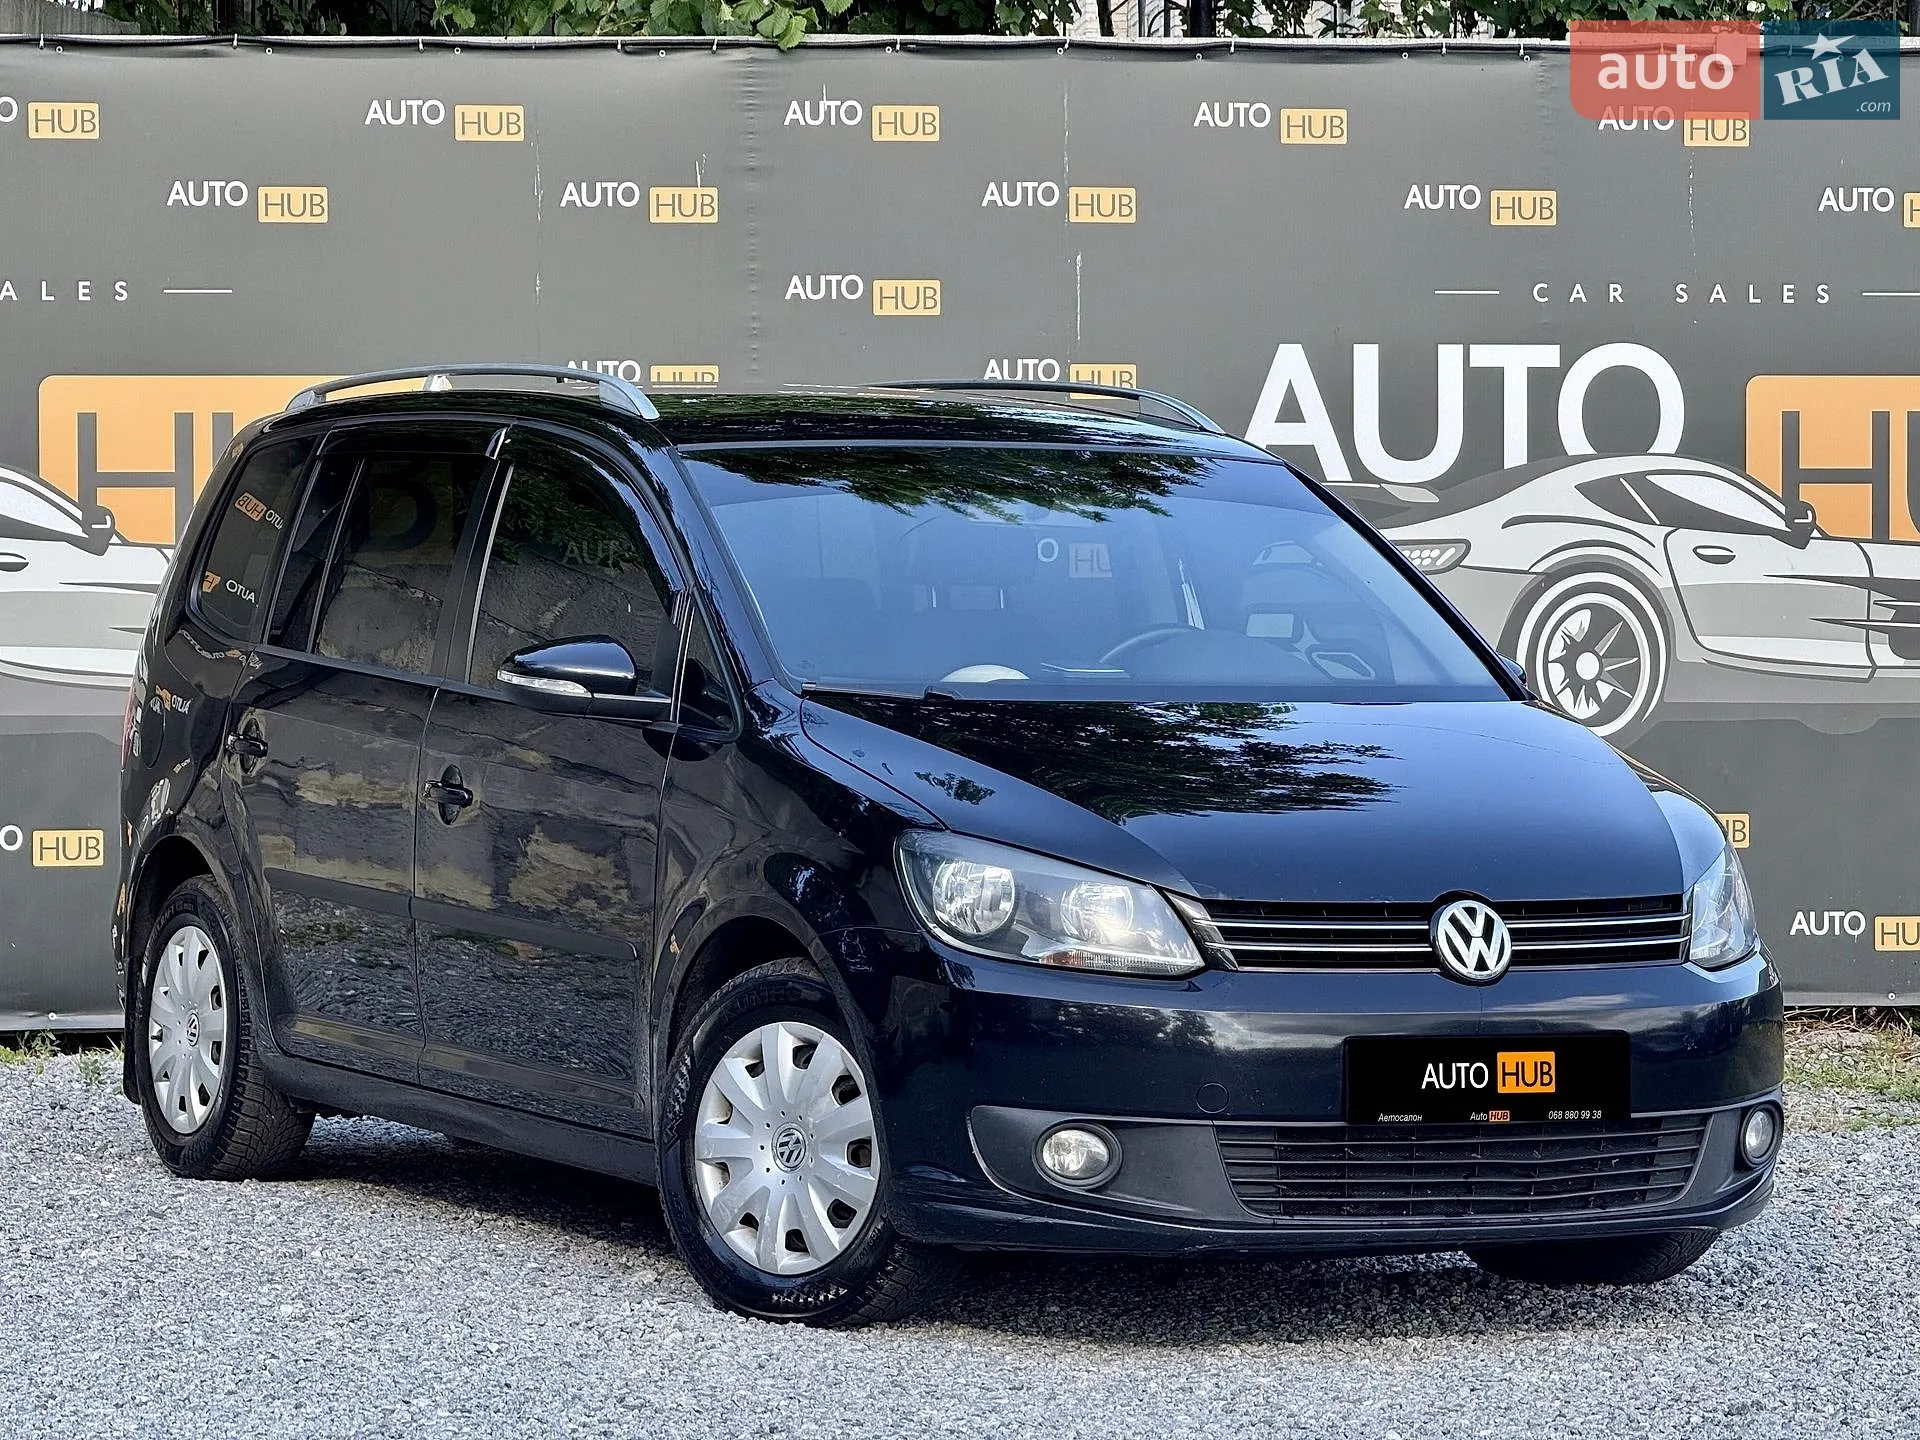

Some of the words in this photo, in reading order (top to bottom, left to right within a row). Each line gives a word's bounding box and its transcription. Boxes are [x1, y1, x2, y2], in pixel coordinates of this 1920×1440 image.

[34, 108, 97, 134] HUB
[364, 99, 446, 126] AUTO
[461, 110, 522, 137] HUB
[783, 100, 863, 126] AUTO
[878, 111, 937, 136] HUB
[1193, 101, 1272, 128] AUTO
[1286, 114, 1345, 139] HUB
[1598, 105, 1675, 131] AUTO
[1690, 118, 1748, 142] HUB
[166, 180, 249, 207] AUTO
[264, 192, 325, 218] HUB
[559, 181, 640, 208] AUTO
[655, 193, 716, 218] HUB
[981, 181, 1060, 207] AUTO
[1075, 192, 1134, 218] HUB
[1403, 184, 1482, 210] AUTO
[1496, 196, 1554, 221] HUB
[1818, 186, 1895, 213] AUTO
[784, 274, 864, 301] AUTO
[879, 286, 938, 311] HUB
[1532, 282, 1624, 303] CAR
[1675, 283, 1830, 304] SALES
[983, 358, 1061, 382] AUTO
[1243, 342, 1685, 485] AUTO
[38, 835, 102, 862] HUB
[1789, 910, 1866, 937] AUTO
[1421, 1062, 1489, 1090] AUTO
[1501, 1060, 1554, 1088] HUB
[1469, 1111, 1488, 1121] Auto
[1490, 1111, 1509, 1120] HUB
[1548, 1110, 1563, 1120] 068
[1580, 1110, 1591, 1120] 99
[1591, 1109, 1602, 1119] 38
